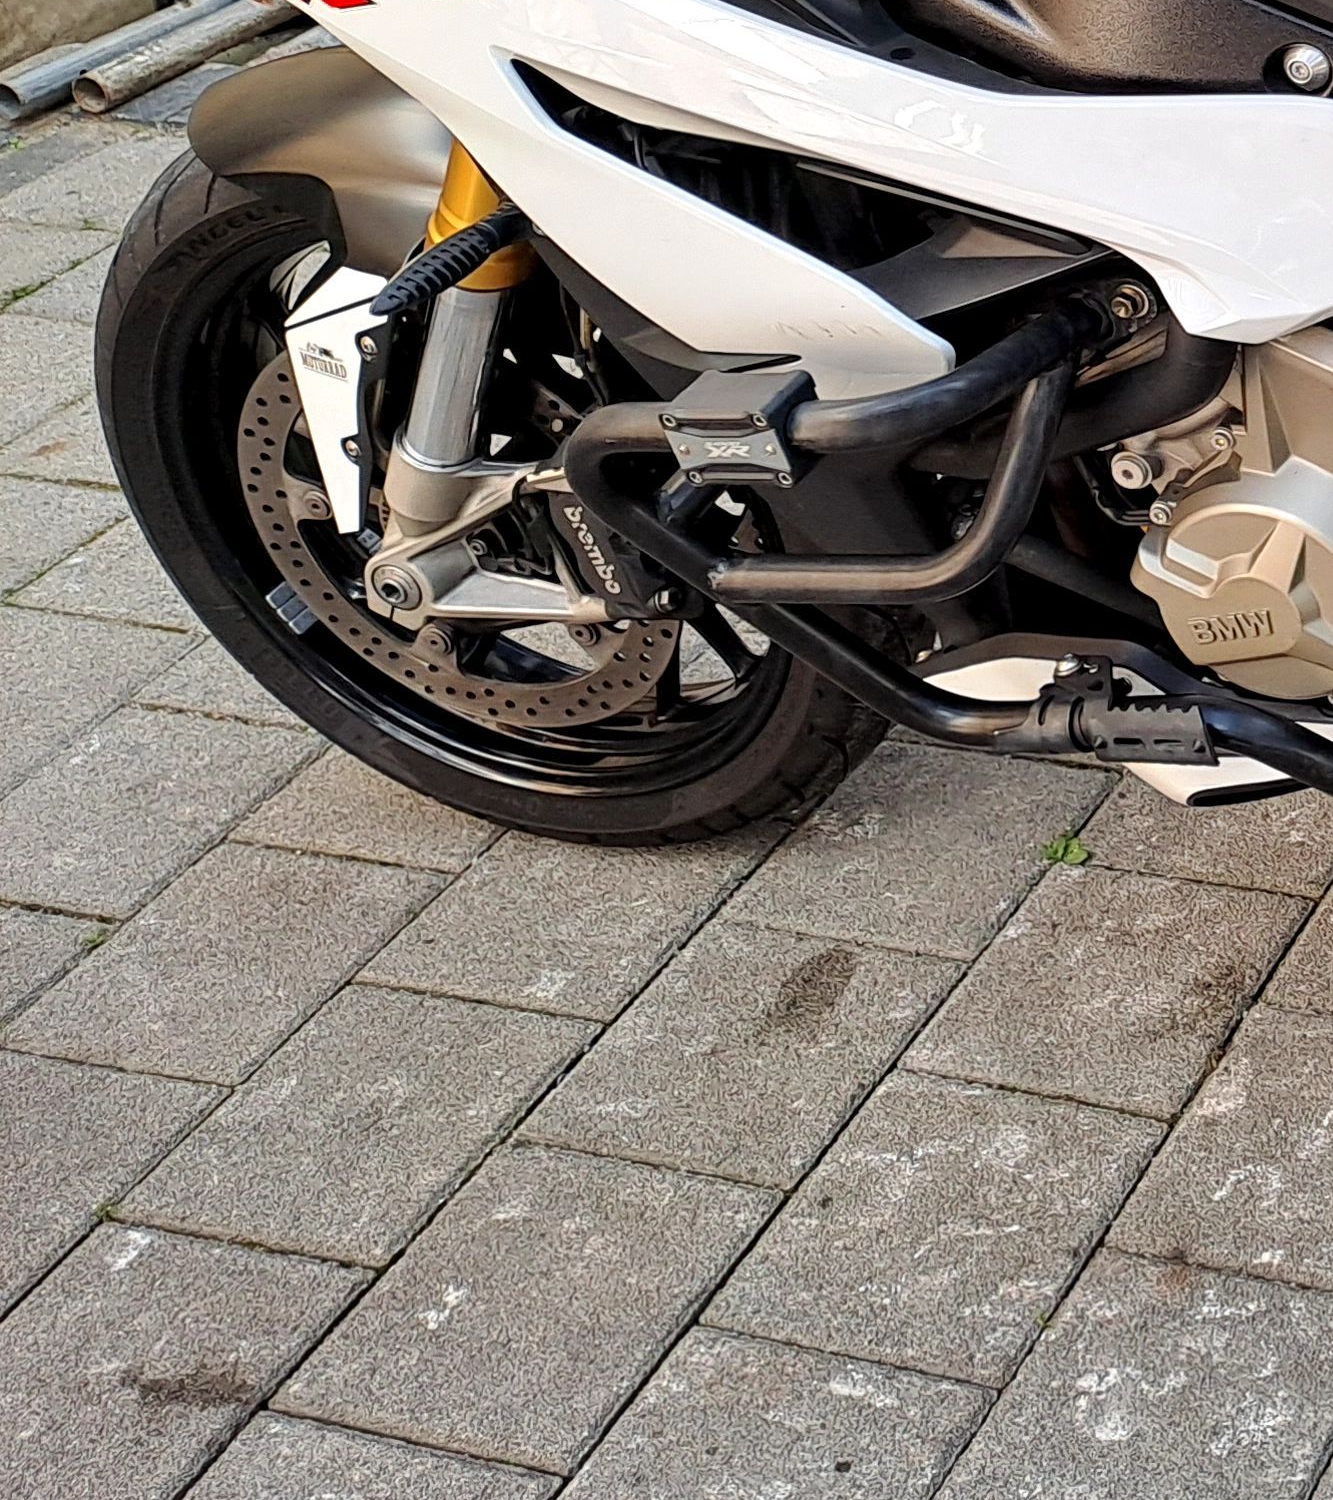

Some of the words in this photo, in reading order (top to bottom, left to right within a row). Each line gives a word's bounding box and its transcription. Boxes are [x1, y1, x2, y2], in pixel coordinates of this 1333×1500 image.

[299, 351, 348, 380] MOTORRAD
[704, 443, 751, 459] XR
[563, 503, 622, 596] brembo
[1187, 607, 1275, 646] BMW
